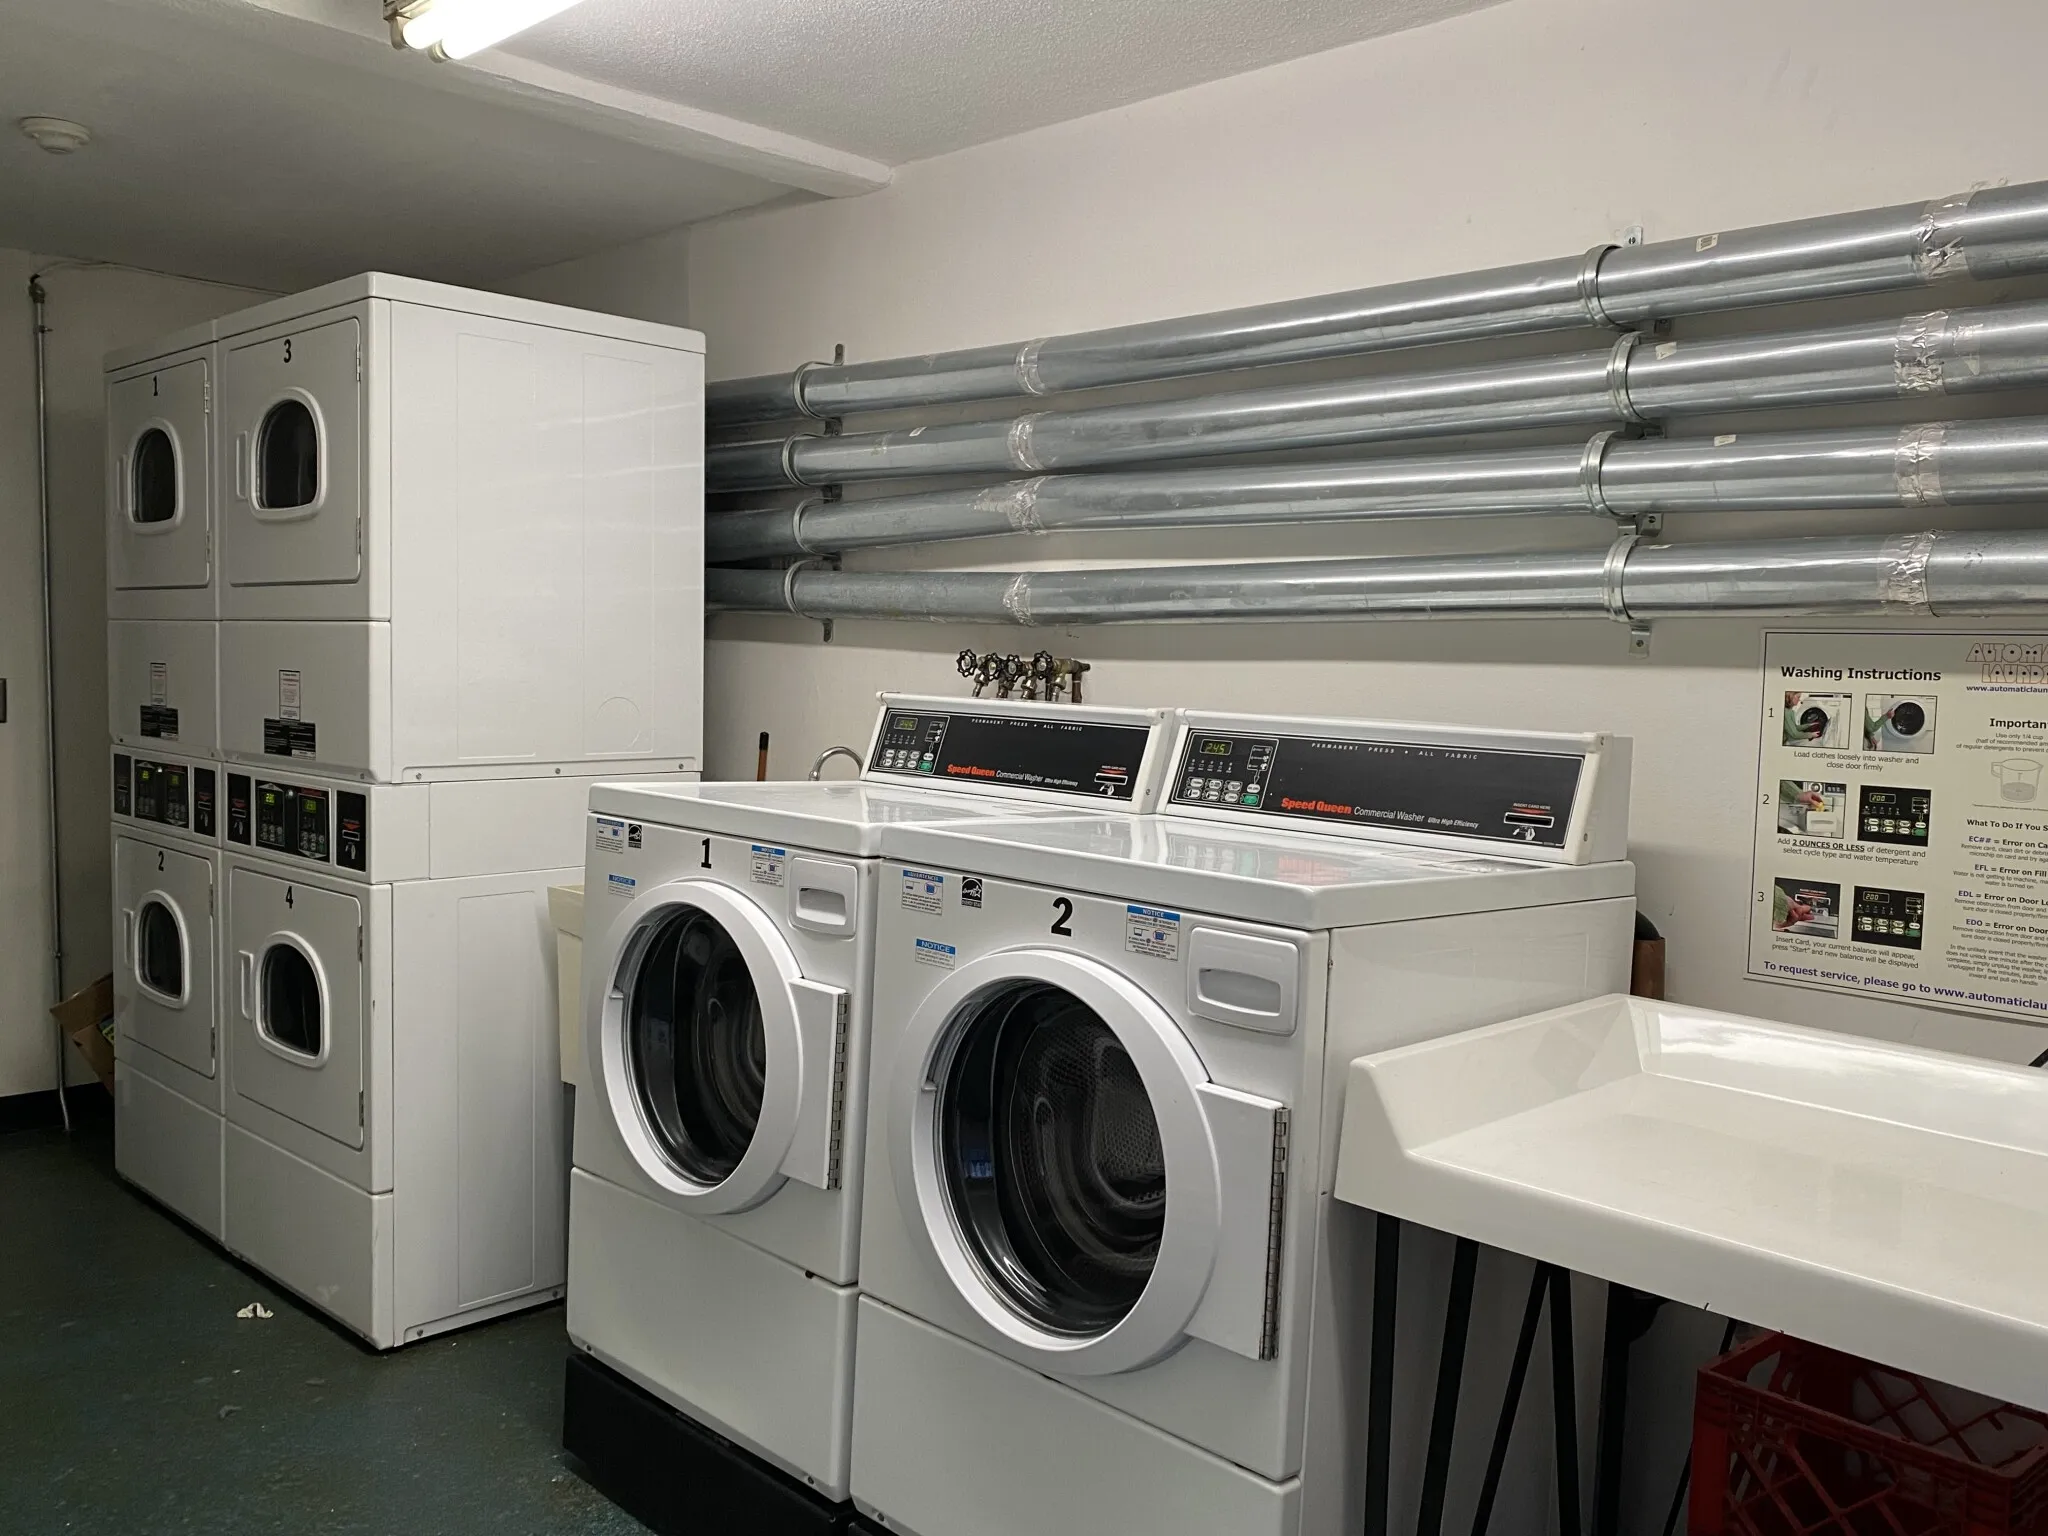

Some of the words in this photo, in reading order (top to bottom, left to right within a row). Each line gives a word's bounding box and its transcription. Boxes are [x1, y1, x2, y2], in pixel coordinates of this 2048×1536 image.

[284, 339, 292, 363] 3
[153, 376, 158, 396] 1
[1966, 643, 2048, 663] AUTOM
[1781, 666, 1843, 681] Washing
[1848, 667, 1941, 681] Instructions
[1768, 707, 1774, 717] 1
[1990, 718, 2048, 729] Importan
[1205, 743, 1225, 754] 245
[1312, 743, 1359, 751] PERMANENT
[1812, 752, 1836, 760] clothes
[1837, 754, 1861, 762] loosely
[947, 764, 971, 774] Speed
[972, 767, 995, 777] Queen
[996, 770, 1024, 781] Commercial
[1024, 773, 1043, 783] Washer
[1863, 763, 1883, 772] firmly
[1762, 794, 1769, 804] 2
[1281, 797, 1315, 810] Speed
[1316, 801, 1351, 814] Queen
[1354, 806, 1395, 819] Commercial
[1396, 811, 1425, 823] Washer
[1441, 818, 1453, 826] High
[1454, 819, 1479, 829] Efficiency
[701, 838, 712, 869] 1
[1783, 847, 1802, 855] select
[1804, 849, 1821, 858] cycle
[1822, 851, 1837, 860] type
[1854, 854, 1873, 862] water
[1875, 856, 1919, 866] temperature
[1799, 840, 1830, 849] OUNCES
[1846, 844, 1865, 852] LESS
[1876, 847, 1910, 857] detergent
[158, 851, 164, 871] 2
[285, 886, 294, 908] 4
[1757, 892, 1764, 902] 3
[1984, 893, 2004, 901] Error
[2019, 897, 2039, 905] Door
[1051, 897, 1074, 937] 2
[1143, 909, 1164, 917] NOTICE
[1994, 922, 2014, 930] Error
[921, 941, 950, 952] NOTICE
[1775, 936, 1794, 944] Insert
[1795, 938, 1811, 947] Card,
[1828, 942, 1851, 951] current
[1853, 946, 1877, 955] balance
[1891, 951, 1915, 961] appear,
[1772, 943, 1788, 952] press
[1790, 945, 1810, 953] "Start"
[1812, 948, 1823, 956] and
[1825, 950, 1838, 958] new
[1840, 951, 1864, 961] balance
[1866, 955, 1877, 963] will
[1888, 958, 1919, 969] displayed
[2000, 956, 2018, 964] minute
[1764, 961, 1776, 970] To
[1779, 964, 1817, 978] request
[1820, 969, 1861, 984] service,
[1864, 975, 1899, 988] please
[1902, 983, 1916, 992] go
[1919, 984, 1931, 993] to
